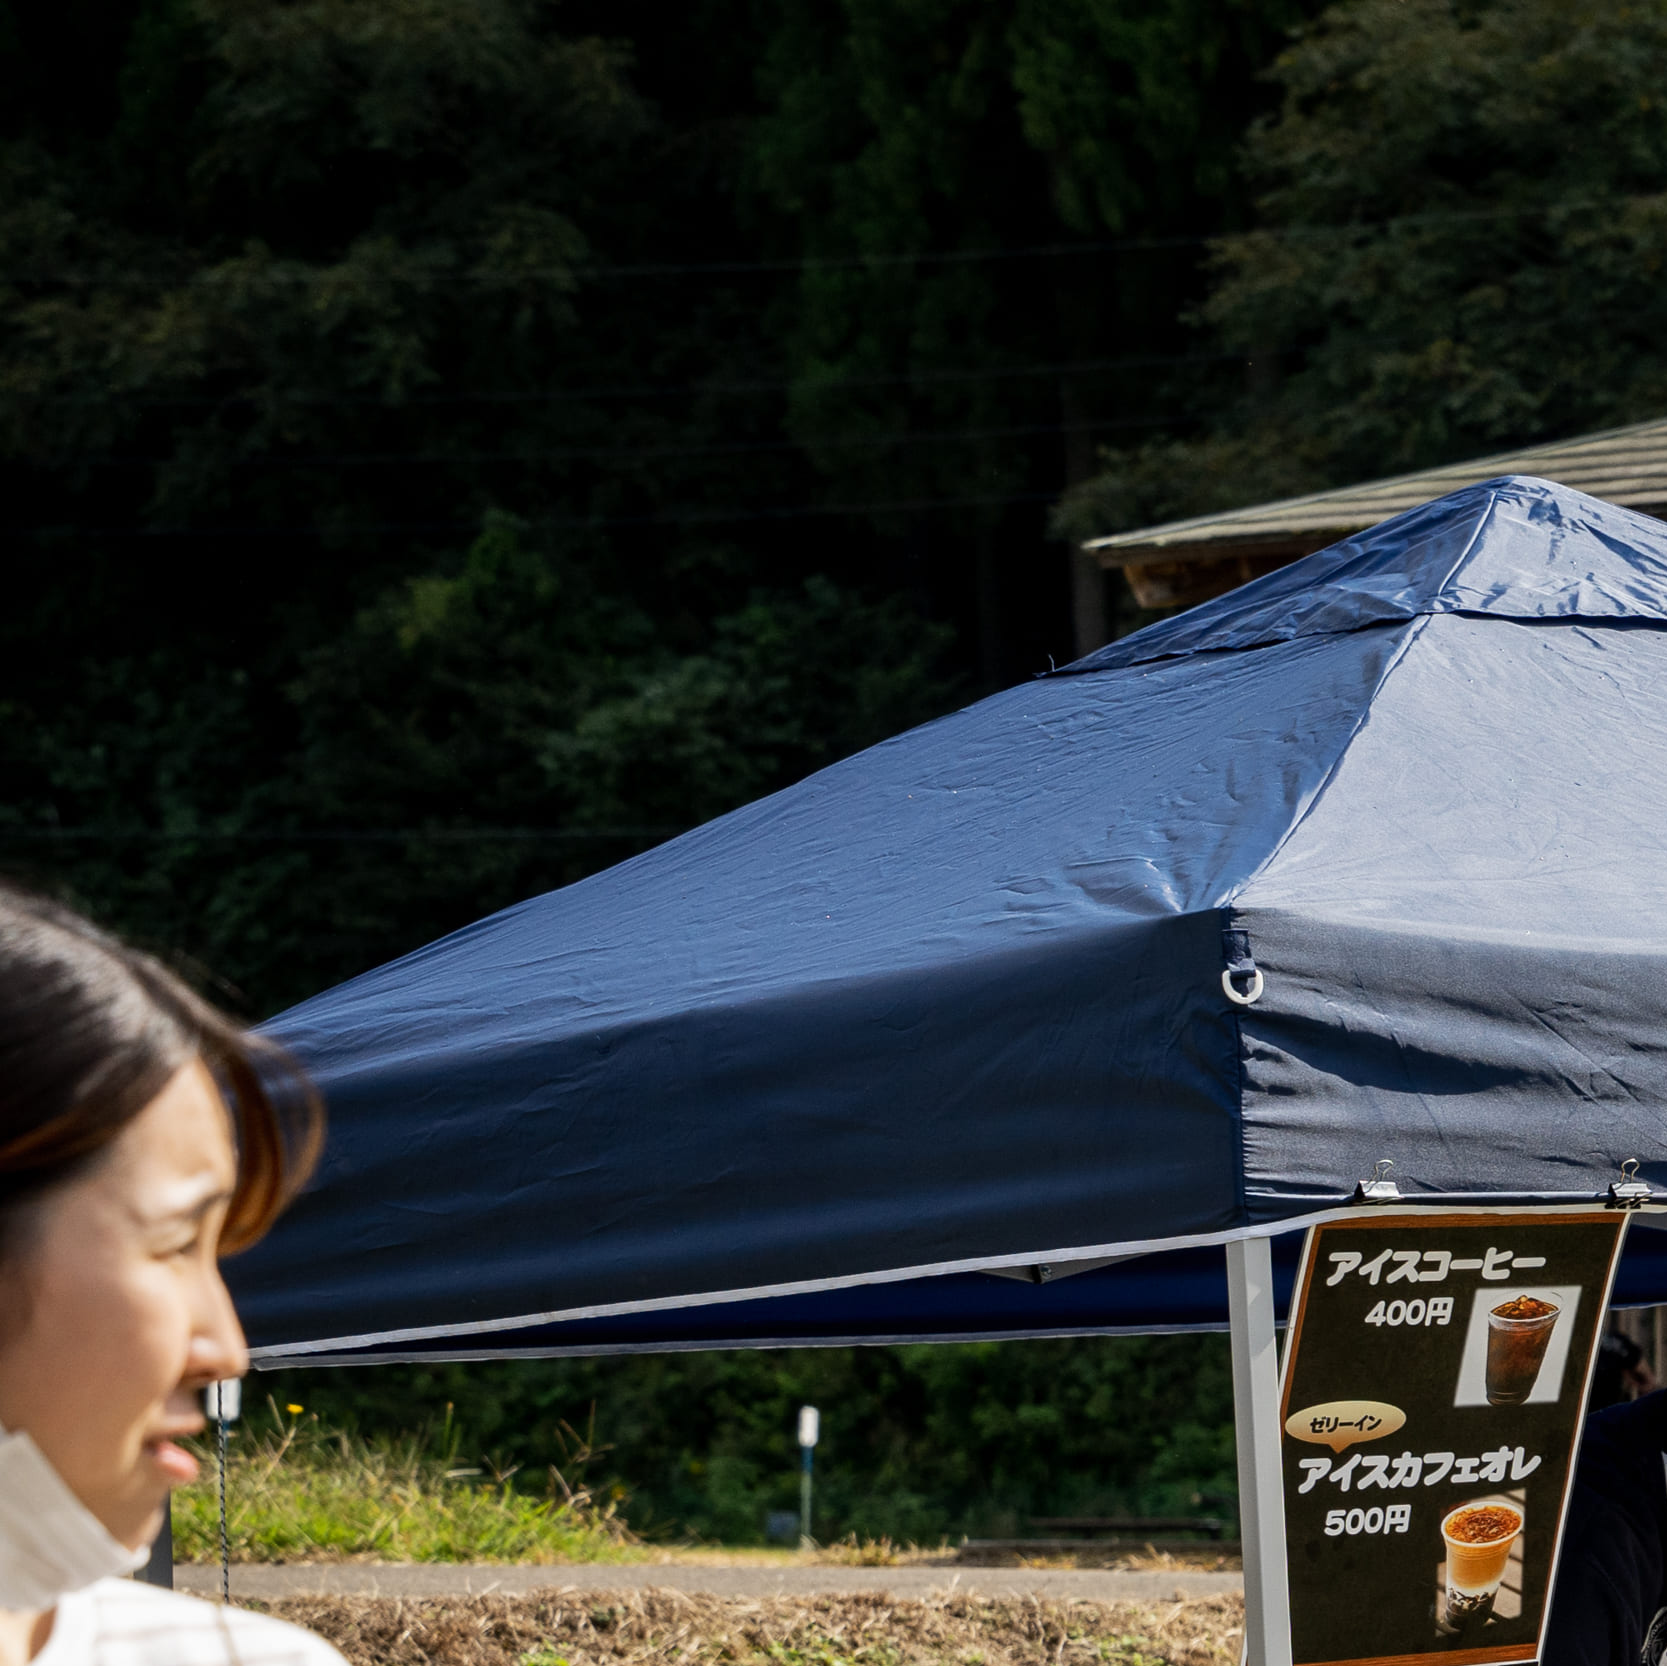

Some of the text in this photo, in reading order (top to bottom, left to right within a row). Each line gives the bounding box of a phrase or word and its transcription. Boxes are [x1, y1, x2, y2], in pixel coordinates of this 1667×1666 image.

[1326, 1247, 1546, 1286] アイスコーヒー
[1364, 1296, 1455, 1328] 400円
[1308, 1413, 1382, 1433] ゼリーイン
[1298, 1446, 1542, 1493] アイスカフェオレ
[1323, 1504, 1412, 1537] 500円
